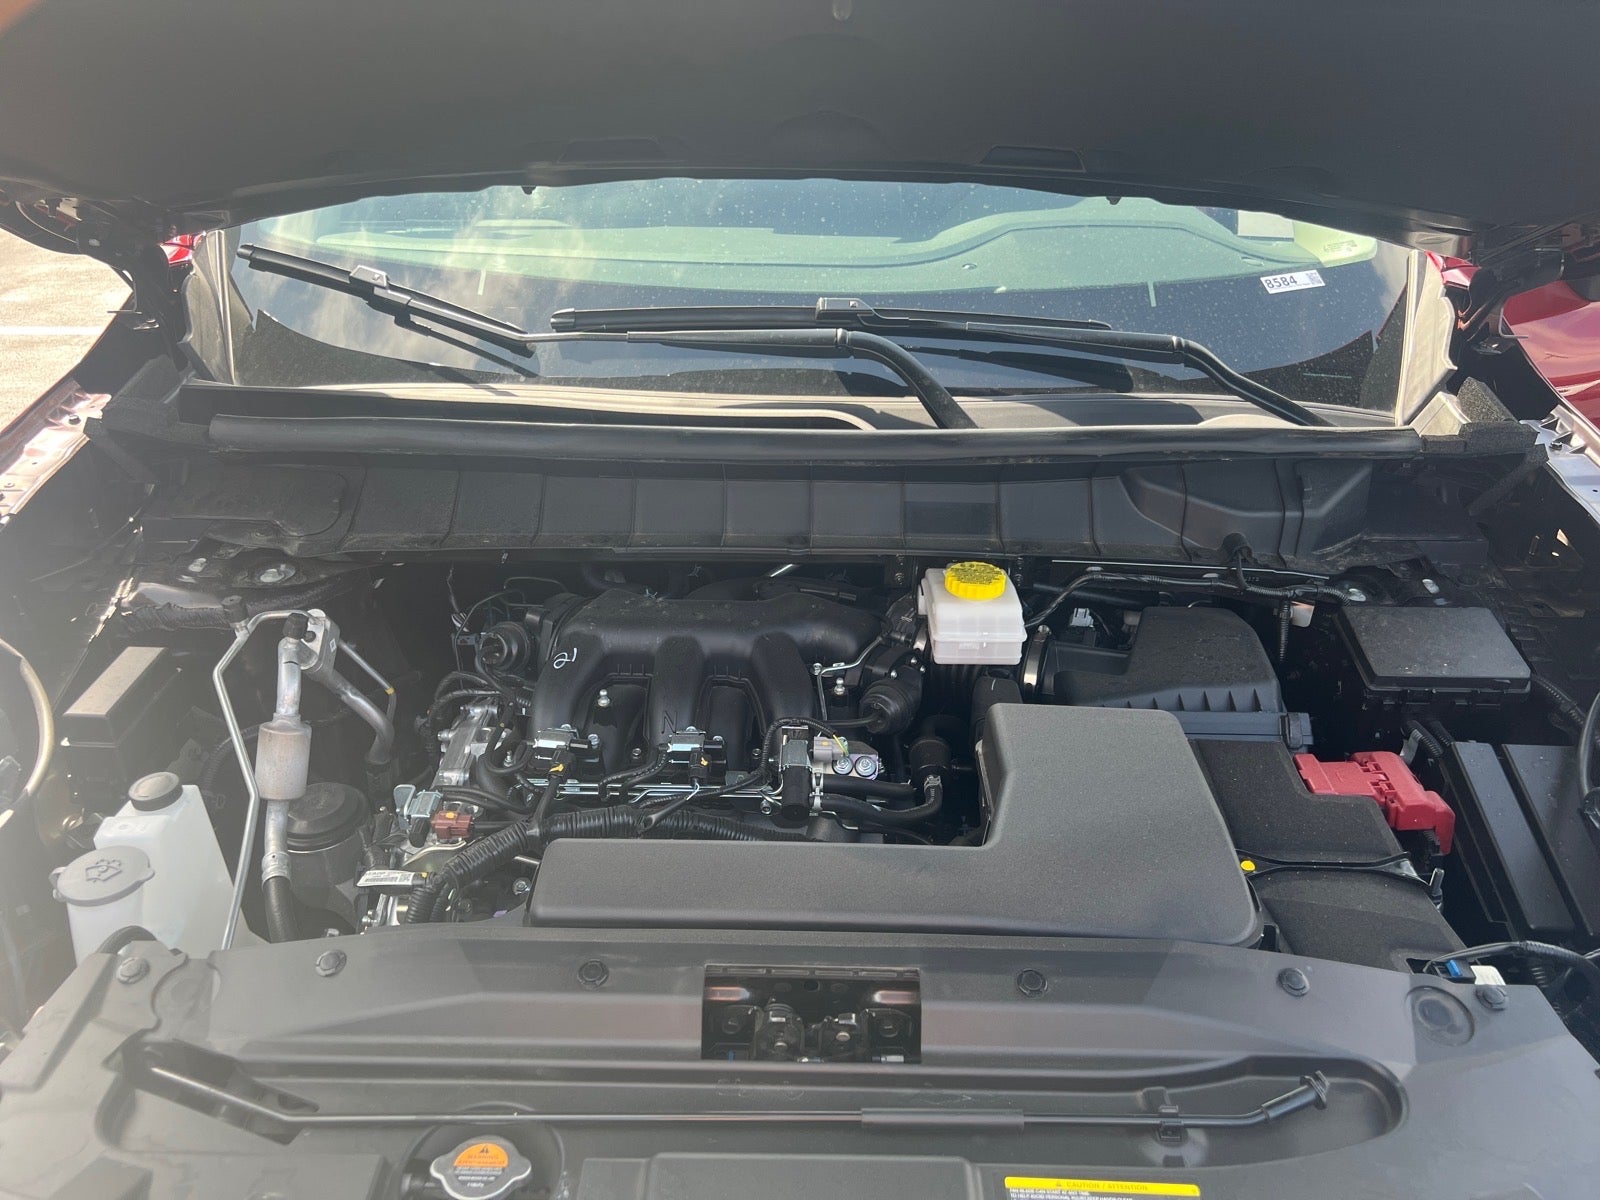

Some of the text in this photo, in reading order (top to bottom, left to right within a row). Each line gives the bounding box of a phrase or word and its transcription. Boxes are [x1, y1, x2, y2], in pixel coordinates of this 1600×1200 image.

[1264, 275, 1298, 289] 8584
[553, 647, 577, 669] 21
[1066, 1181, 1100, 1189] CAUTION
[1106, 1183, 1148, 1191] ATTENTION
